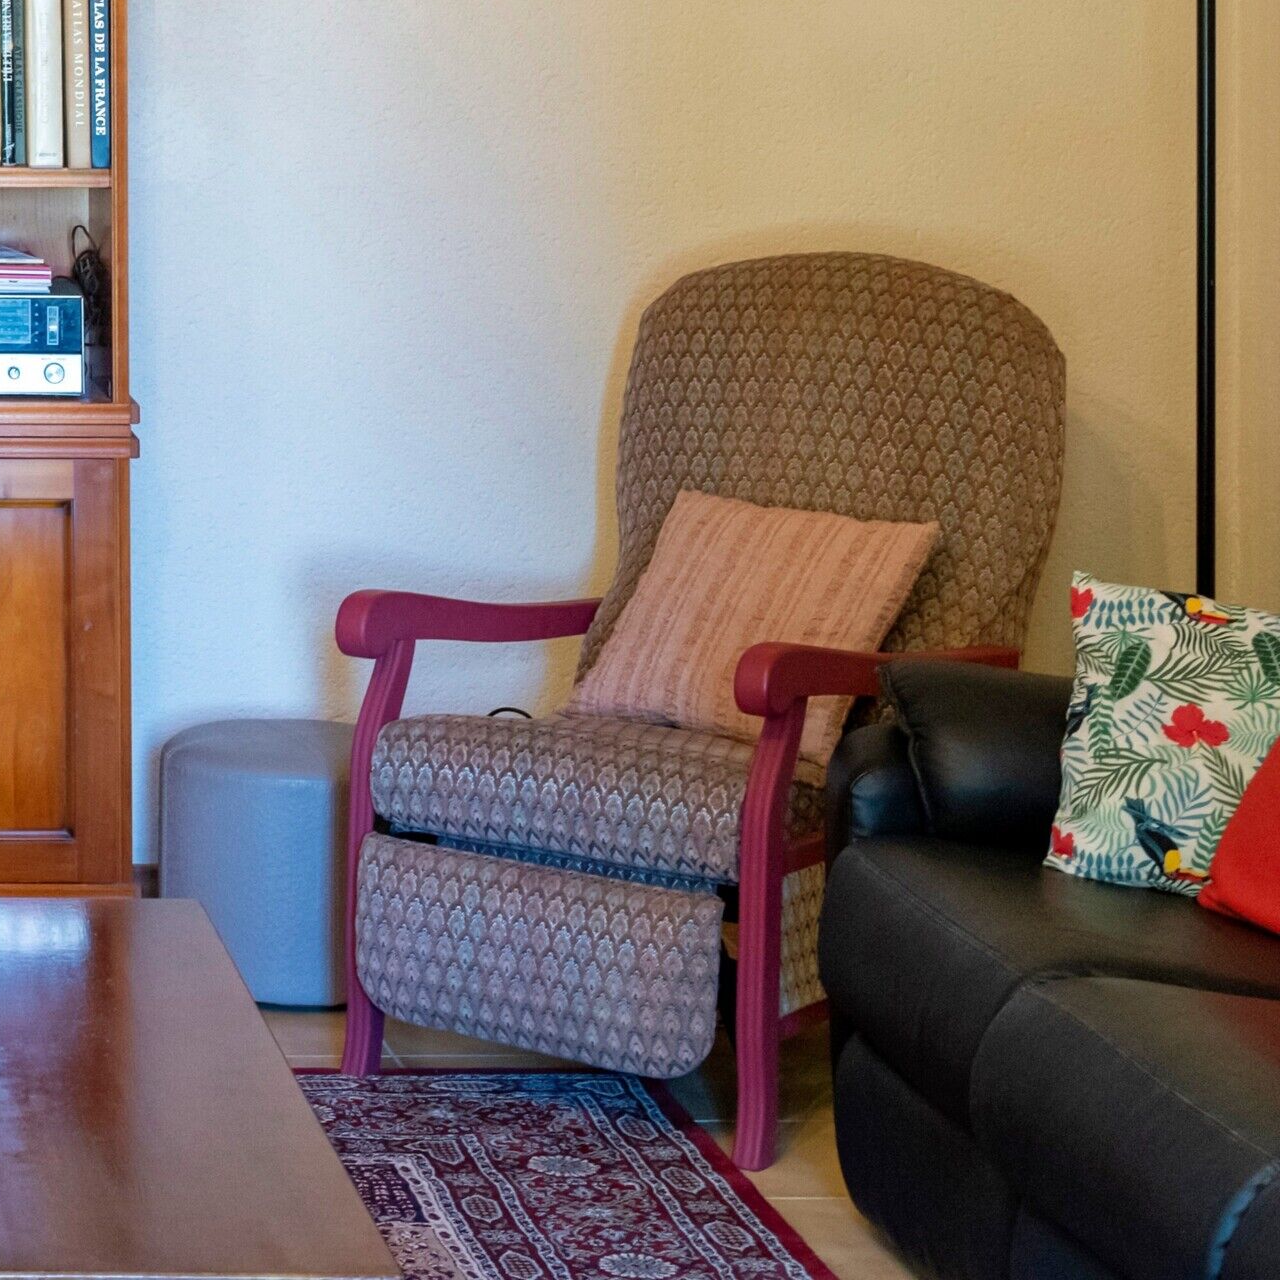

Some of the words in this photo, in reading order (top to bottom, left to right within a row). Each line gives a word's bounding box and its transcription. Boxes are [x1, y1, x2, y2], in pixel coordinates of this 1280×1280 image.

[72, 1, 83, 44] ATLAS
[94, 33, 105, 52] DE
[14, 45, 23, 76] ATLAS
[94, 57, 105, 75] LA
[14, 79, 23, 134] CLASSIQUE
[73, 53, 85, 128] MONDIAL
[95, 79, 106, 135] FRANCE
